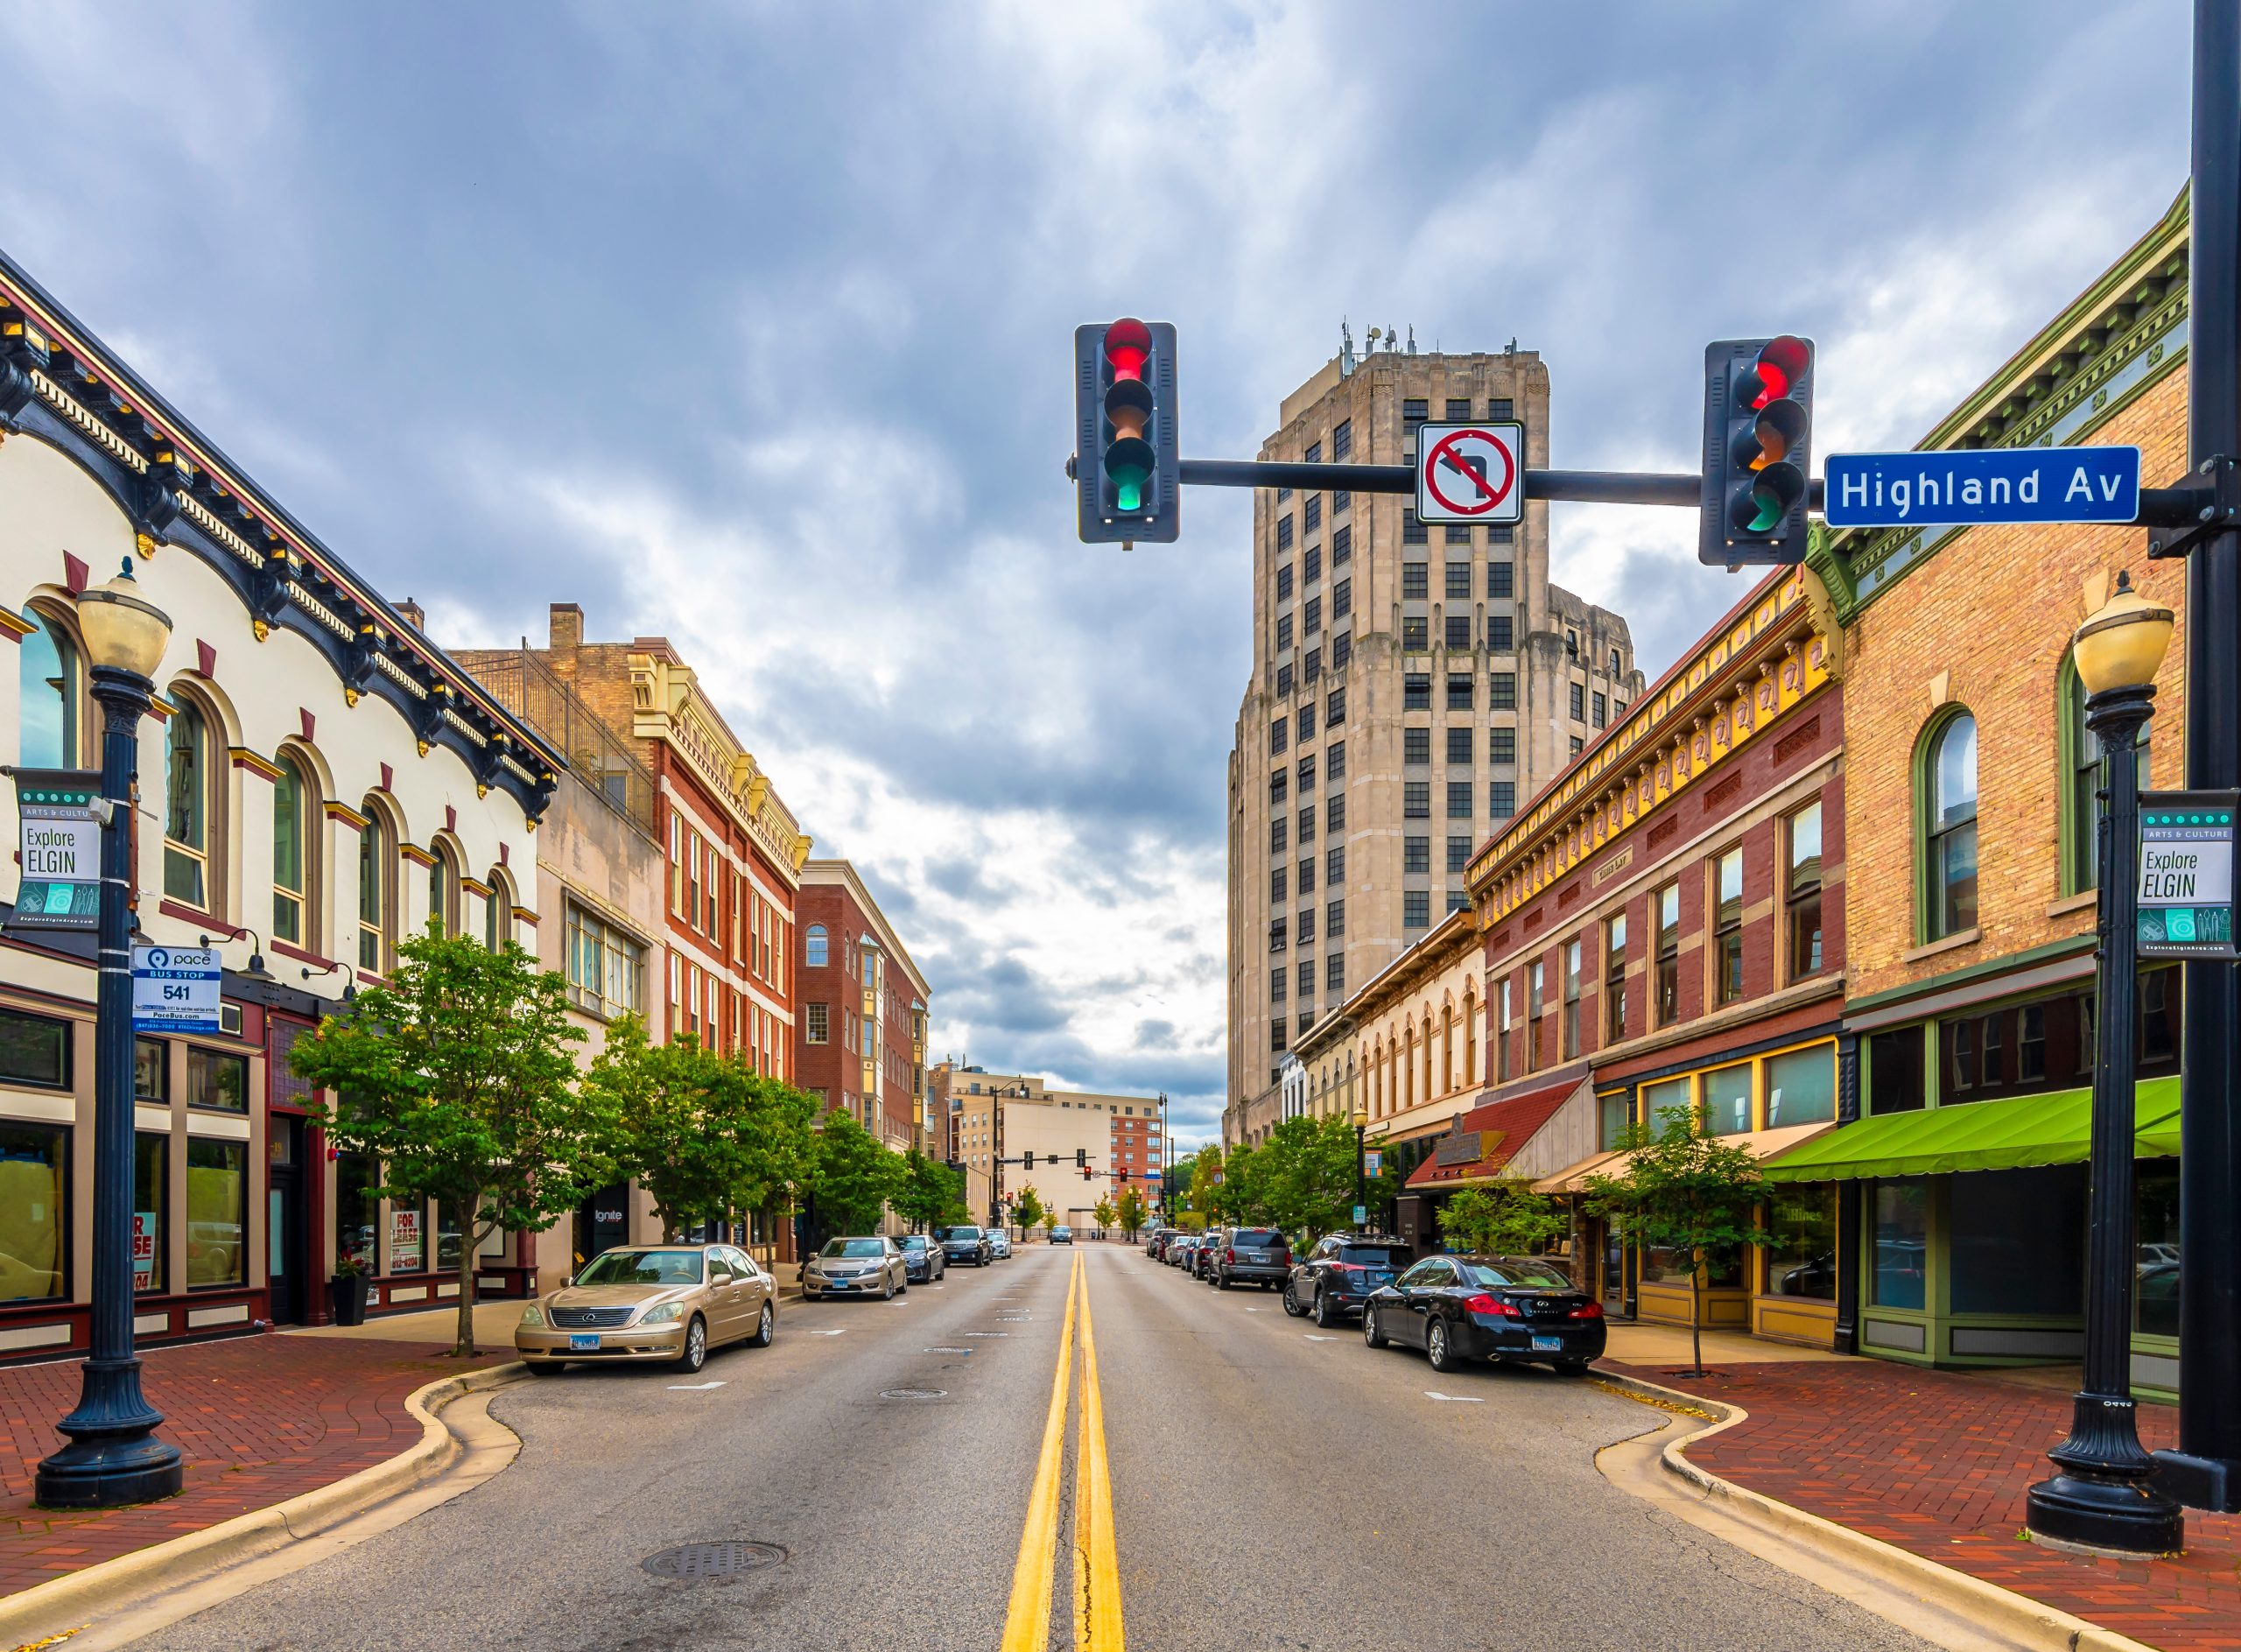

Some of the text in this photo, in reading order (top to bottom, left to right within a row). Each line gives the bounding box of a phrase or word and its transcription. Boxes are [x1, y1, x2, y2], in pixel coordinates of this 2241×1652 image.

[1842, 466, 2122, 518] Highland Av
[27, 828, 75, 849] Explore
[28, 850, 75, 874] ELGIN
[2146, 850, 2198, 874] Explore
[2143, 874, 2195, 898] ELGIN
[173, 954, 211, 966] pace
[163, 985, 190, 1001] 541
[397, 1213, 414, 1227] FOR
[595, 1209, 622, 1222] Ignite
[392, 1227, 418, 1243] LEASE
